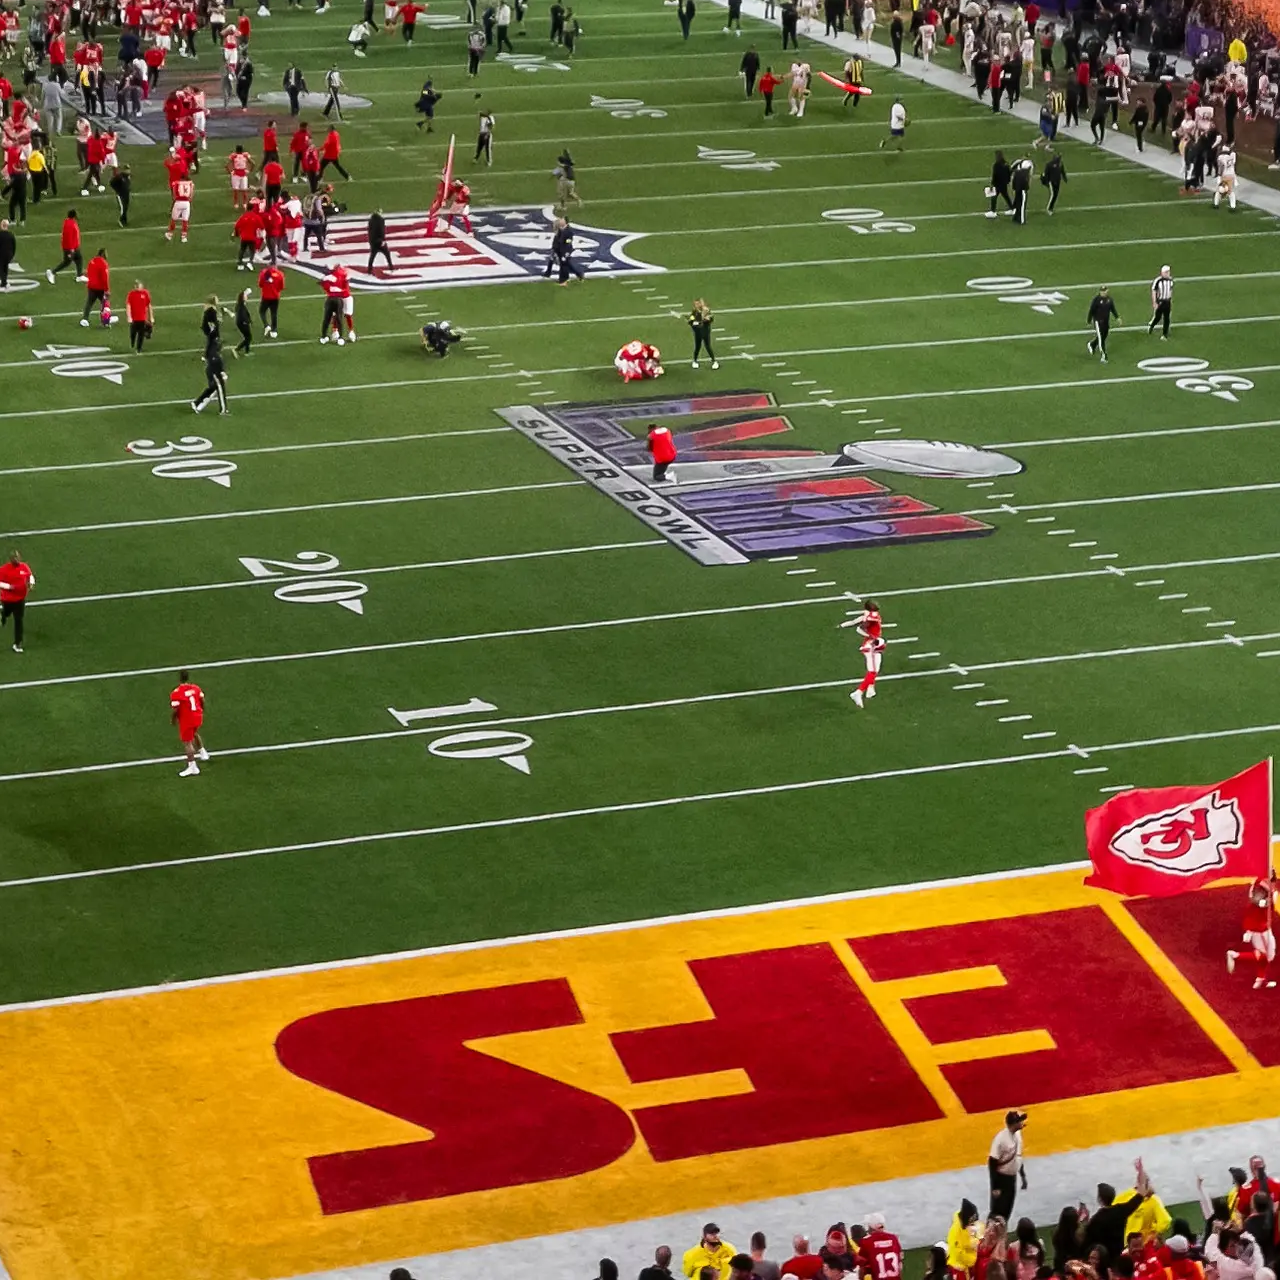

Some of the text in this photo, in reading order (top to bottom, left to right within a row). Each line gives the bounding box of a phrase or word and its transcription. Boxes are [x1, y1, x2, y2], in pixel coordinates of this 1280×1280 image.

[126, 436, 238, 479] 30
[517, 419, 710, 549] SUPER BOWL
[238, 551, 369, 603] 20
[387, 697, 533, 759] 10
